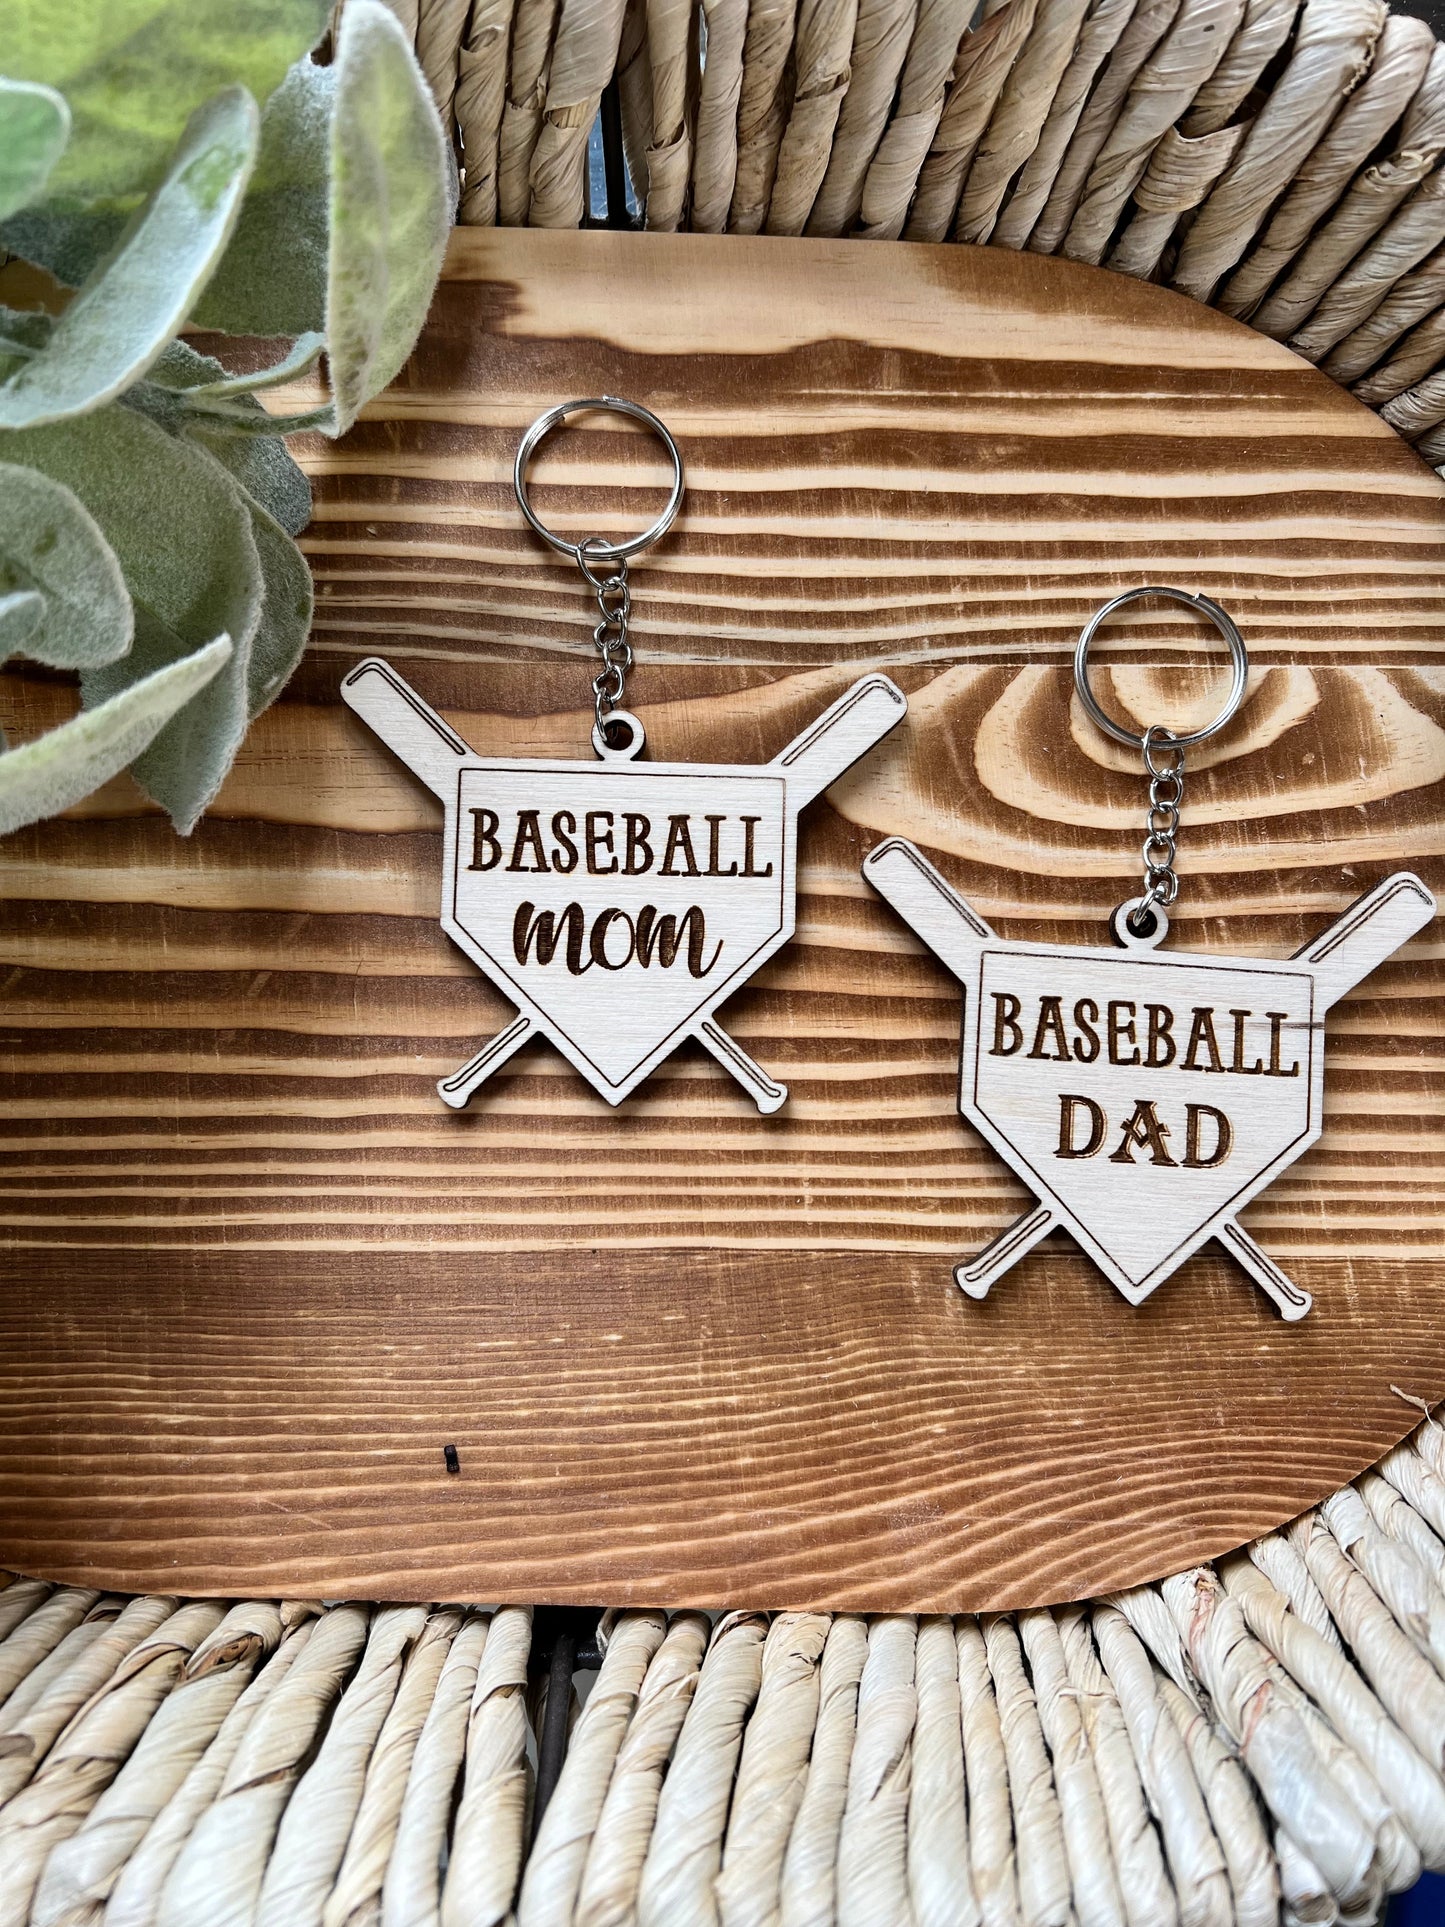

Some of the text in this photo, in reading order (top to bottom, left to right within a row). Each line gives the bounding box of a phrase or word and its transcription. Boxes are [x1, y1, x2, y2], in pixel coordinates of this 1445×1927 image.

[467, 807, 773, 878] BASEBALL
[988, 991, 1299, 1078] BASEBALL
[1052, 1093, 1234, 1169] DAD
